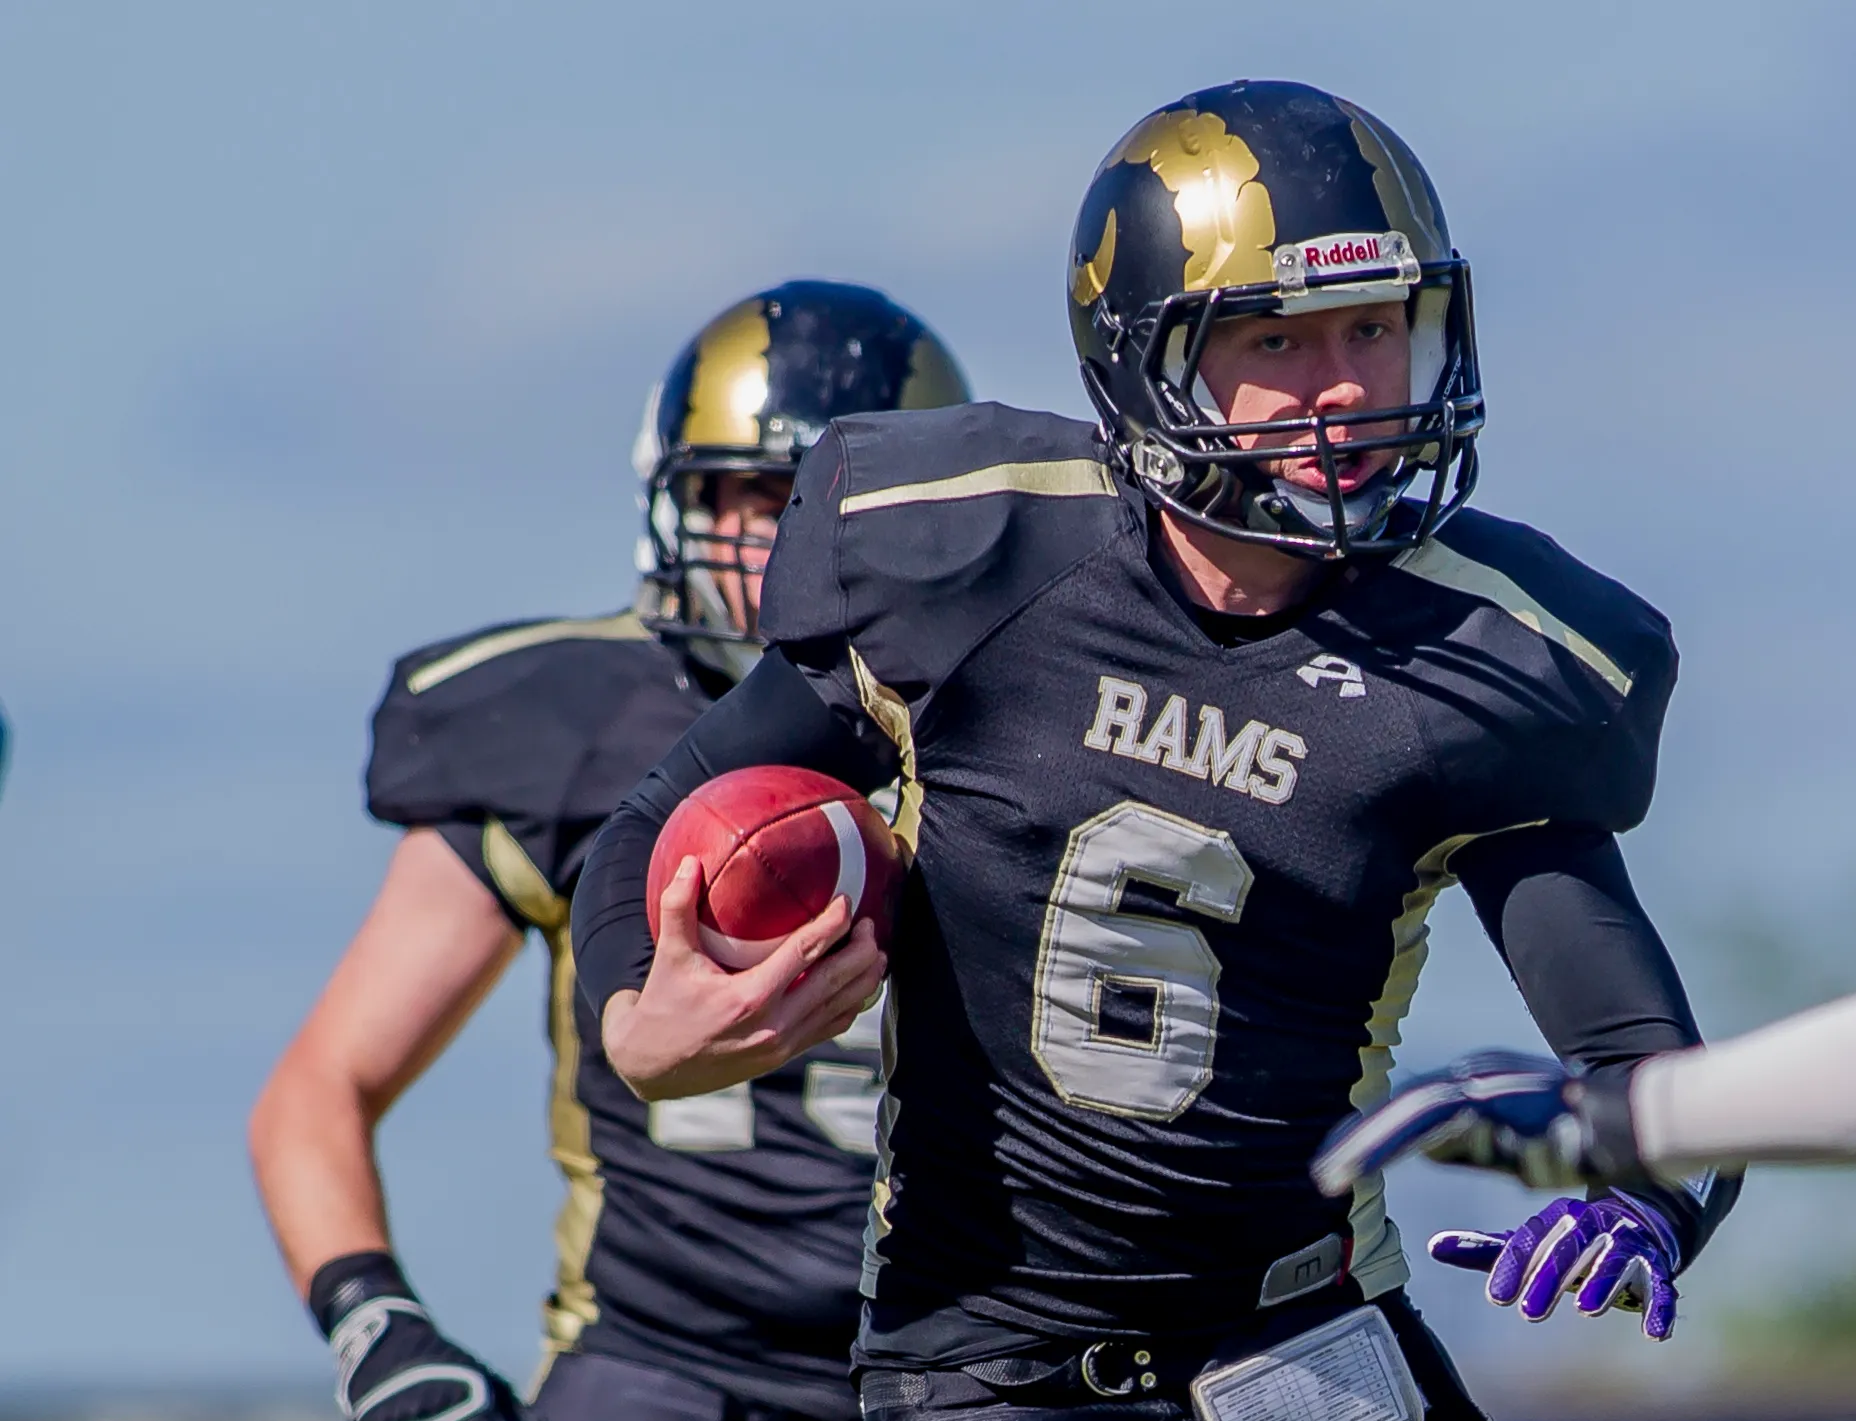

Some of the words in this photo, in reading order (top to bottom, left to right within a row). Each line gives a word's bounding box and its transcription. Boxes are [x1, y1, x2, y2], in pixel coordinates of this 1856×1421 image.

[1304, 238, 1380, 267] Riddell
[1084, 676, 1307, 804] RAMS
[1031, 800, 1254, 1122] 6
